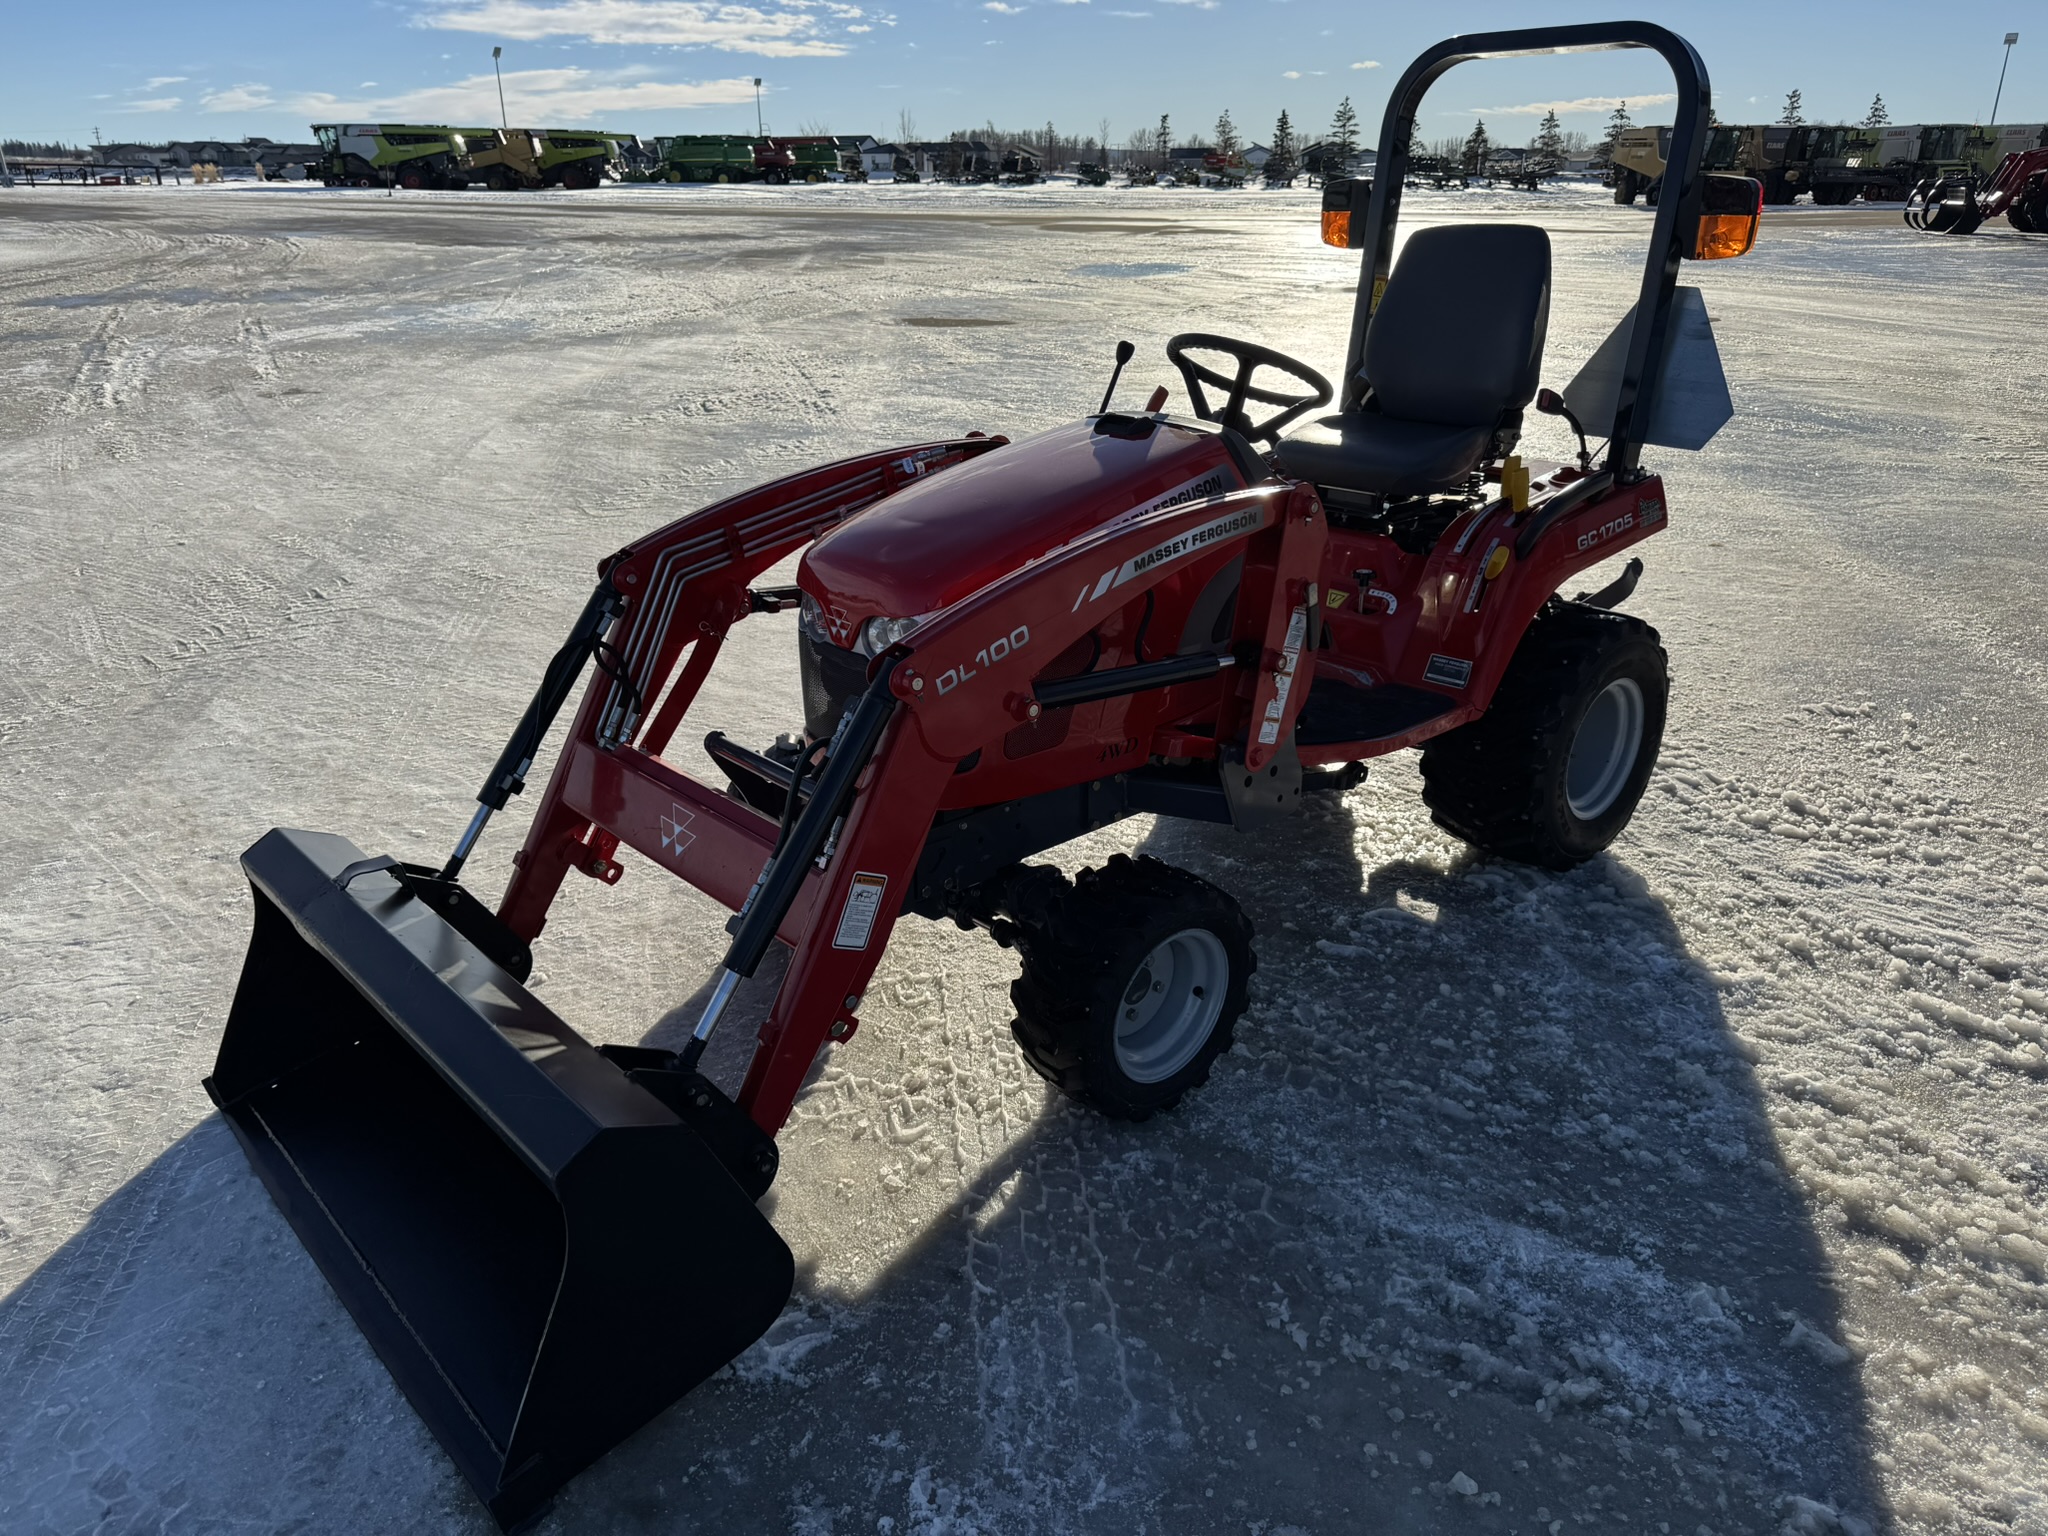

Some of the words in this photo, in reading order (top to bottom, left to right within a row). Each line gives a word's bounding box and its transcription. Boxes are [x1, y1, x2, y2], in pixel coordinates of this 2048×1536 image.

[1133, 537, 1189, 573] MASSEY
[1192, 512, 1257, 546] FERGUSON
[1096, 736, 1139, 763] 4WD
